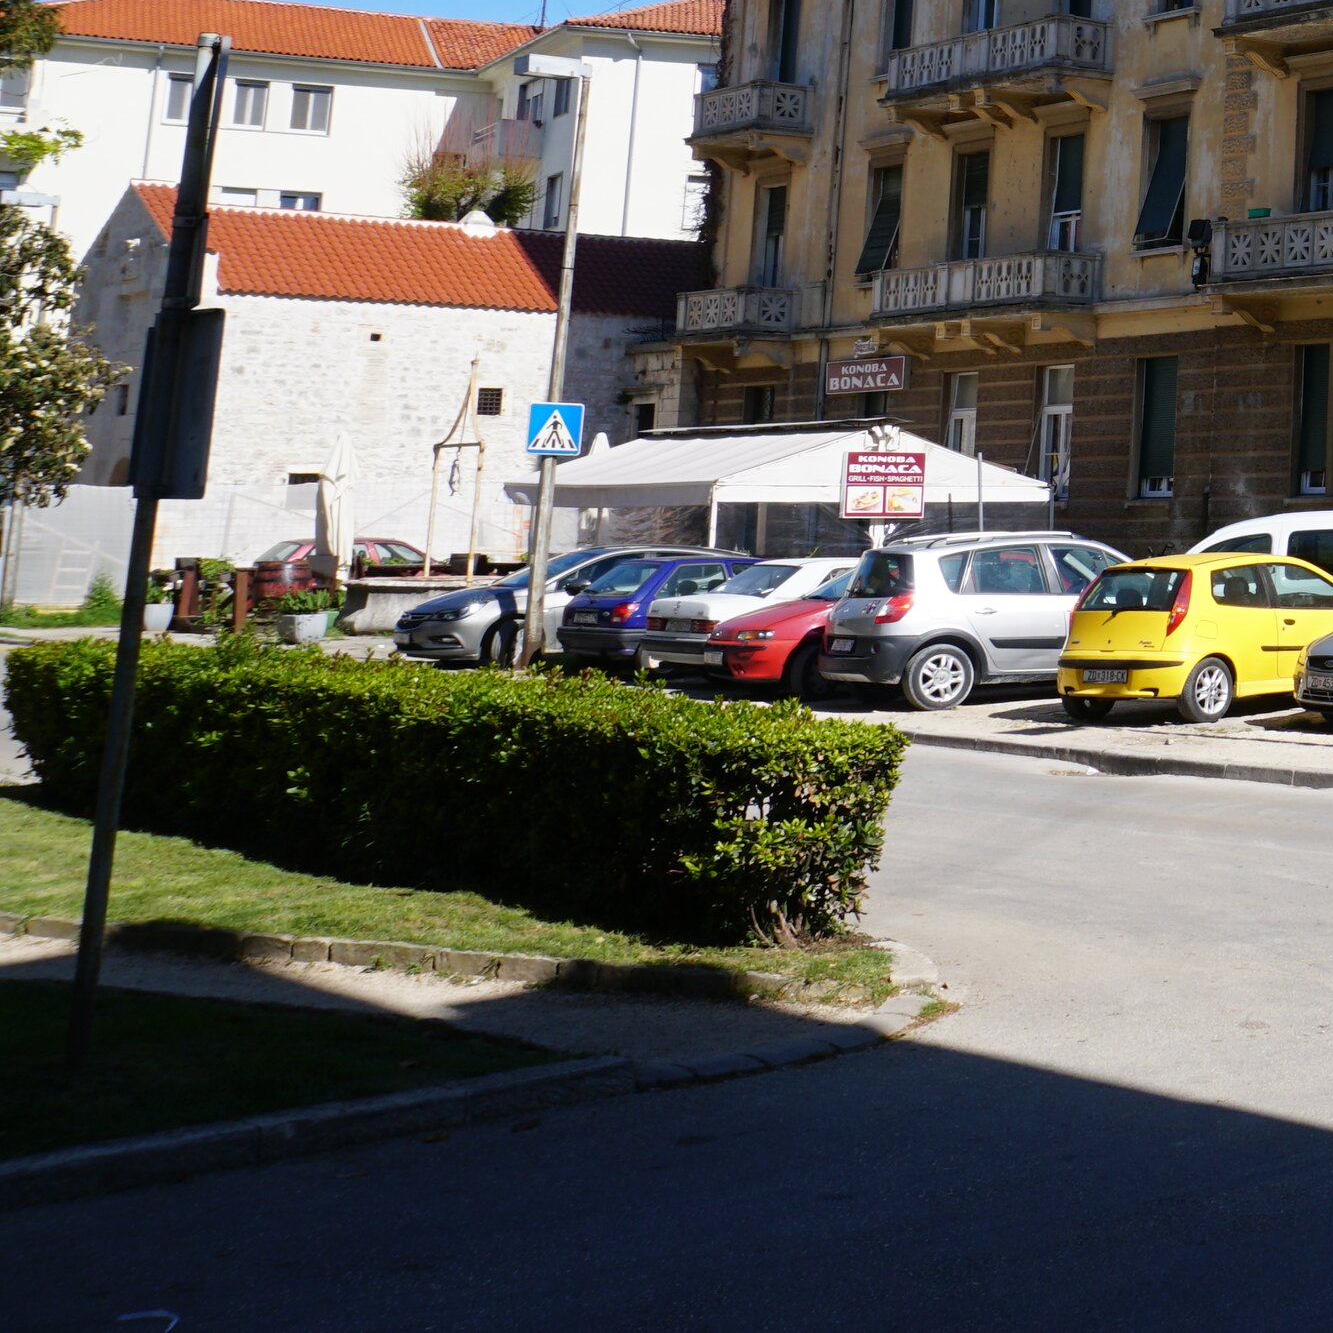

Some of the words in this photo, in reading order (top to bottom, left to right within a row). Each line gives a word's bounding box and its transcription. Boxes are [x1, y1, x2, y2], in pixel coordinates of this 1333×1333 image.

[841, 362, 888, 375] KONOBA
[829, 373, 899, 390] BONACA
[858, 455, 917, 463] KONOBA
[848, 464, 923, 474] BONACA
